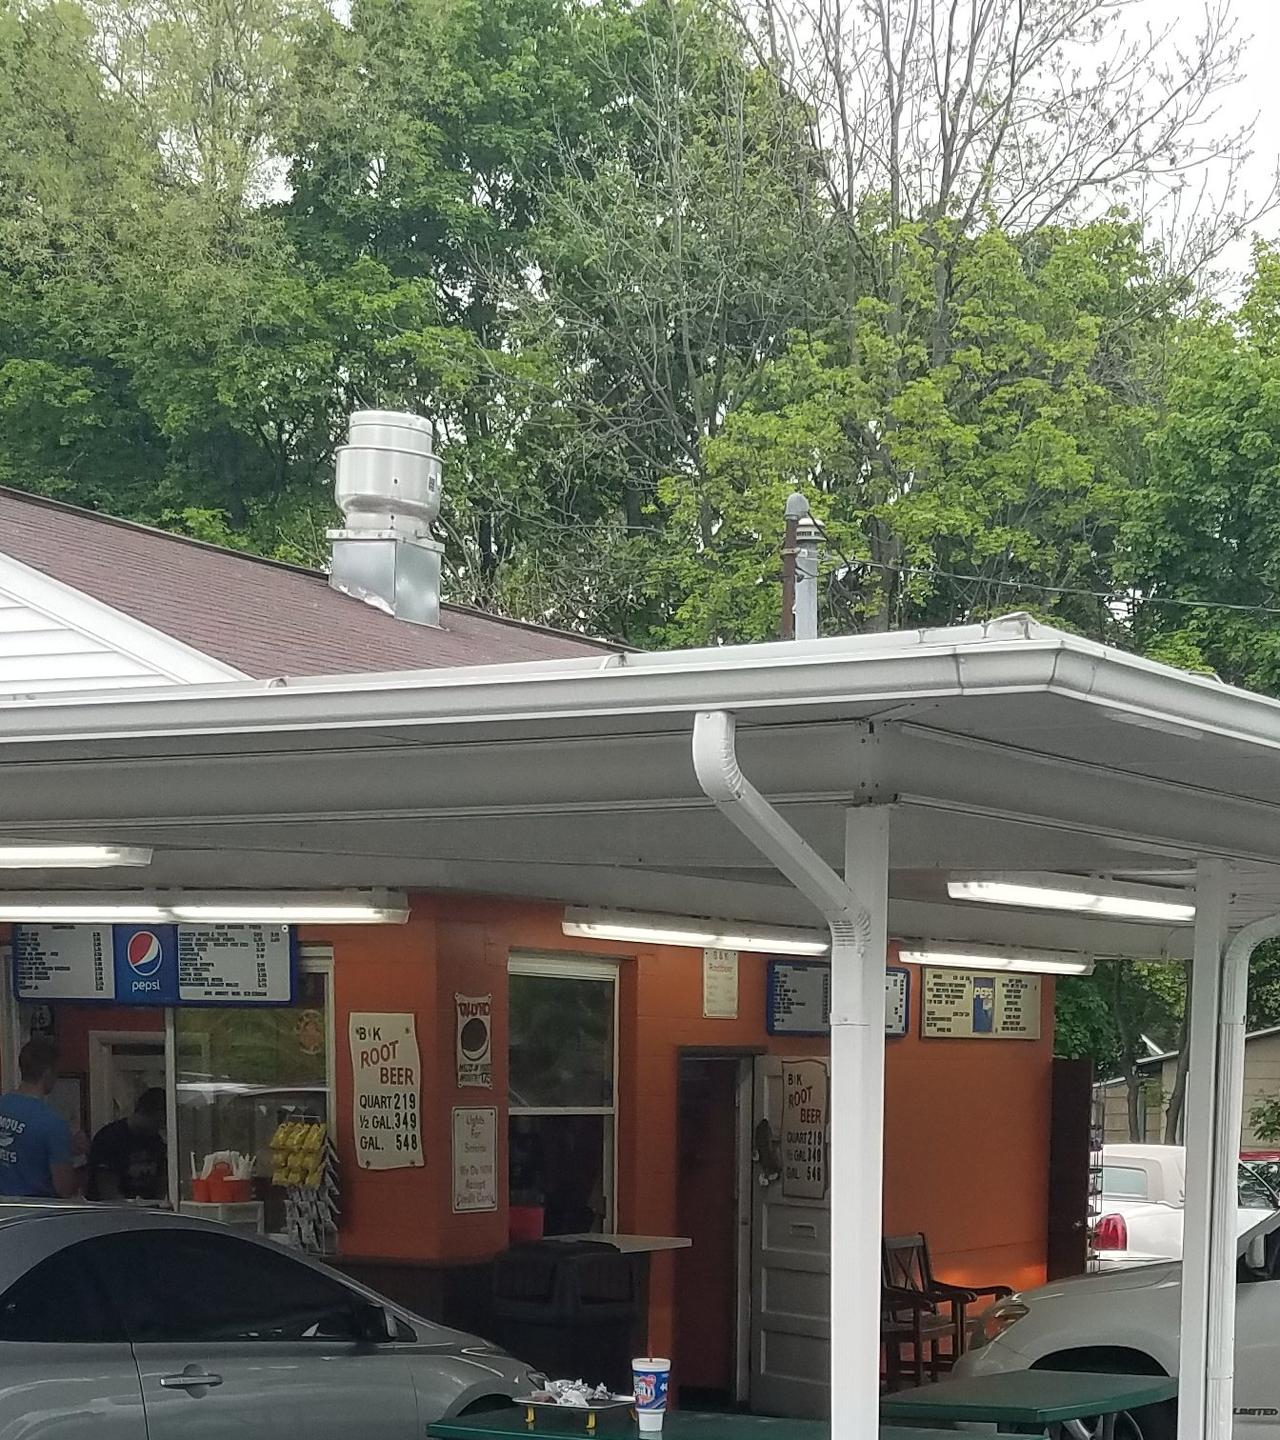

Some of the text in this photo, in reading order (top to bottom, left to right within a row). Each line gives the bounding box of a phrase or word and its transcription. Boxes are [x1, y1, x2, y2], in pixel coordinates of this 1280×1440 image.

[131, 979, 161, 993] pepsi
[359, 1027, 382, 1041] B K
[360, 1040, 399, 1069] ROOT
[379, 1067, 414, 1085] BEER
[359, 1093, 416, 1110] QUART 219
[789, 1086, 813, 1108] ROOT
[372, 1114, 395, 1130] GAL.
[395, 1112, 417, 1129] 349
[801, 1108, 822, 1124] BEER
[360, 1133, 418, 1151] GAL. 548
